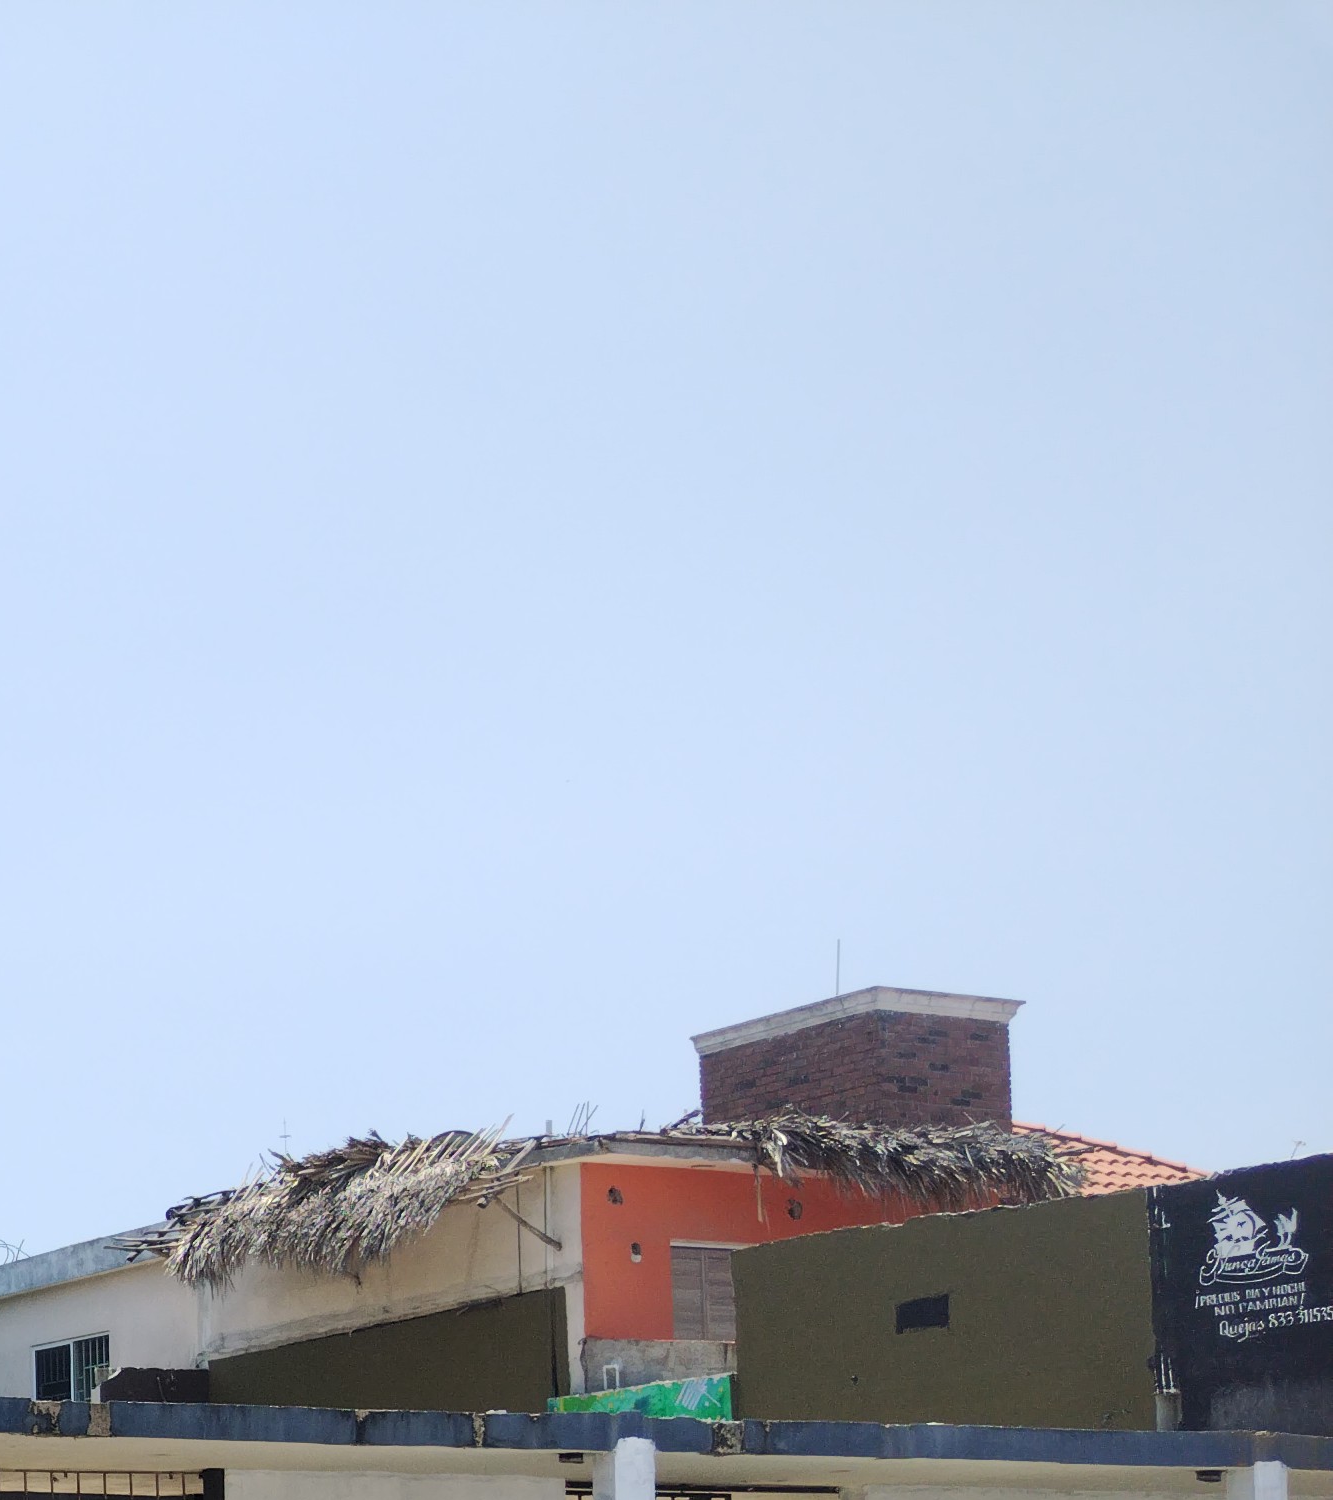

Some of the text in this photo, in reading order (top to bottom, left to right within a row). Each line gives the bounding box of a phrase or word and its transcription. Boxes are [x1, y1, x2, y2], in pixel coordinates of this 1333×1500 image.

[1262, 1287, 1270, 1297] Y
[1214, 1304, 1235, 1316] NO
[1219, 1317, 1265, 1342] Quejas
[1268, 1311, 1294, 1328] 833
